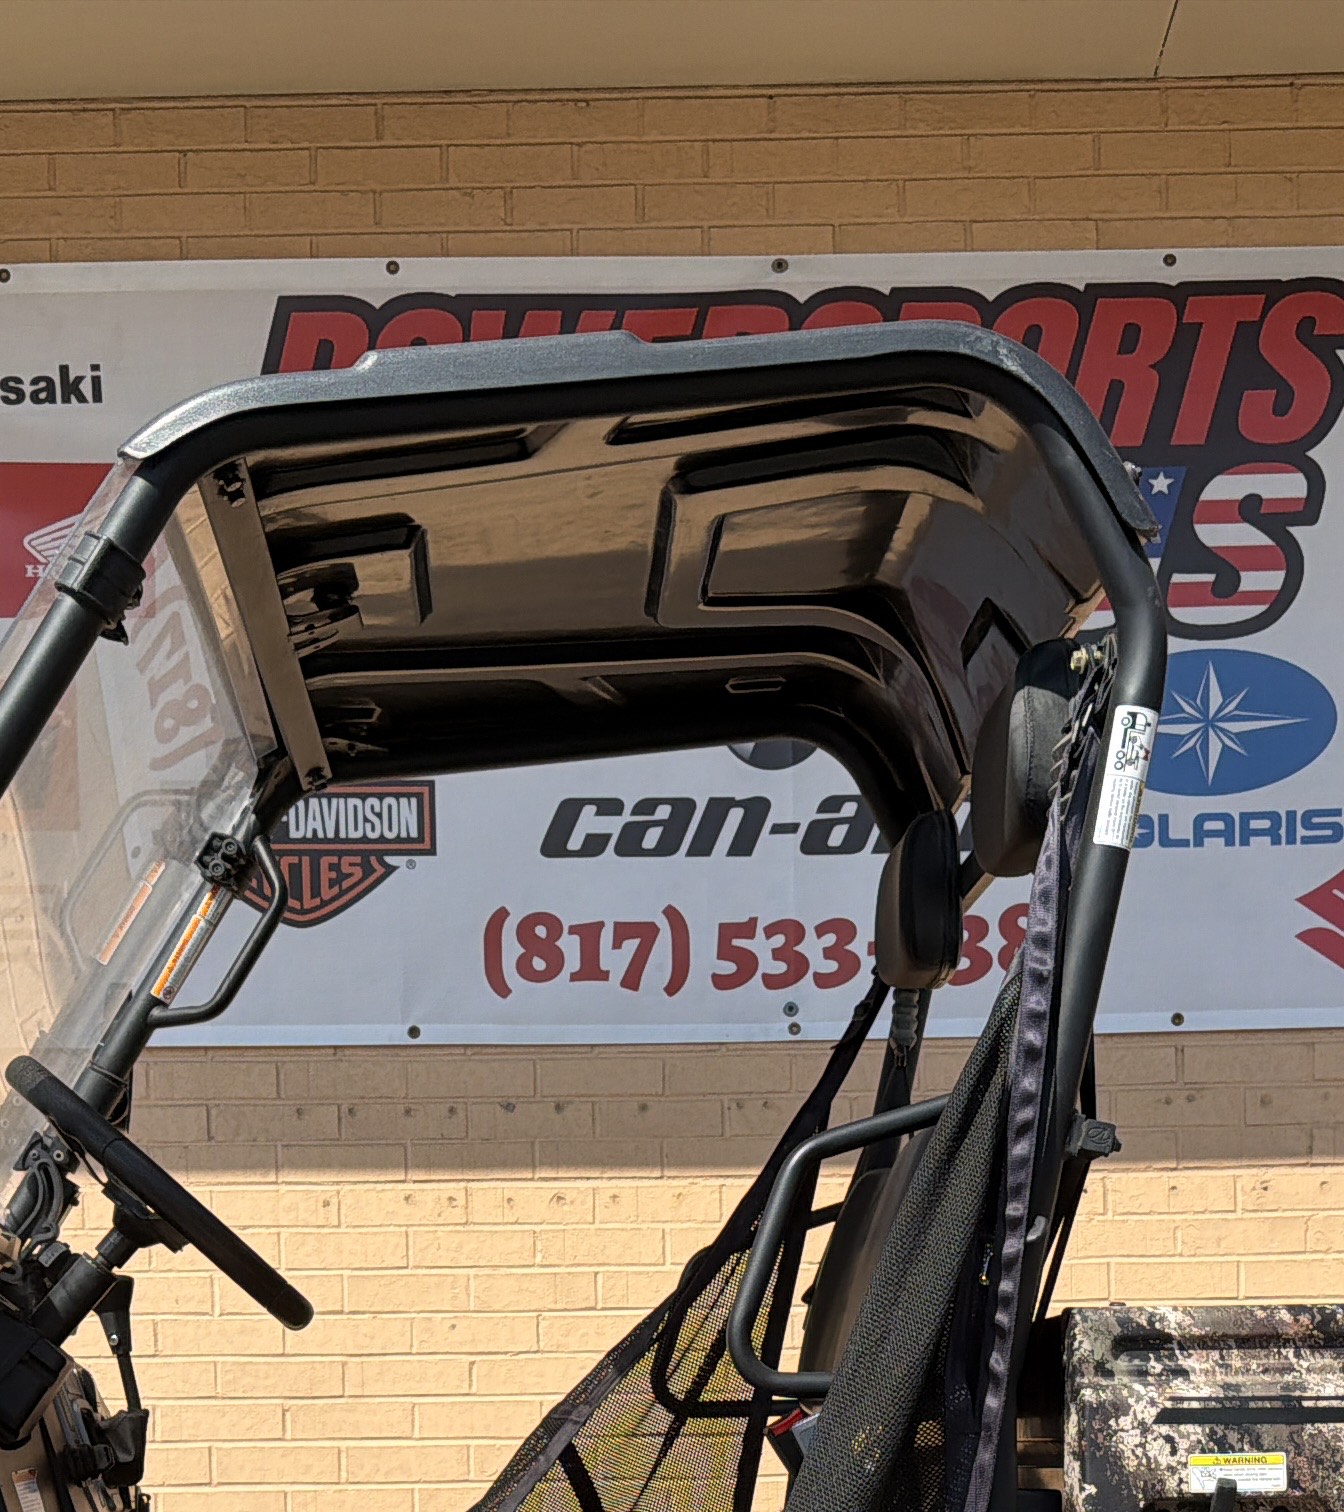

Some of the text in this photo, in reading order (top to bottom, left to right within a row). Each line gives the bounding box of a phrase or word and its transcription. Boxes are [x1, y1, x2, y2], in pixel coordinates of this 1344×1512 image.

[539, 795, 974, 858] can-a
[482, 903, 691, 1000] (817)
[1223, 1456, 1268, 1465] WARNING
